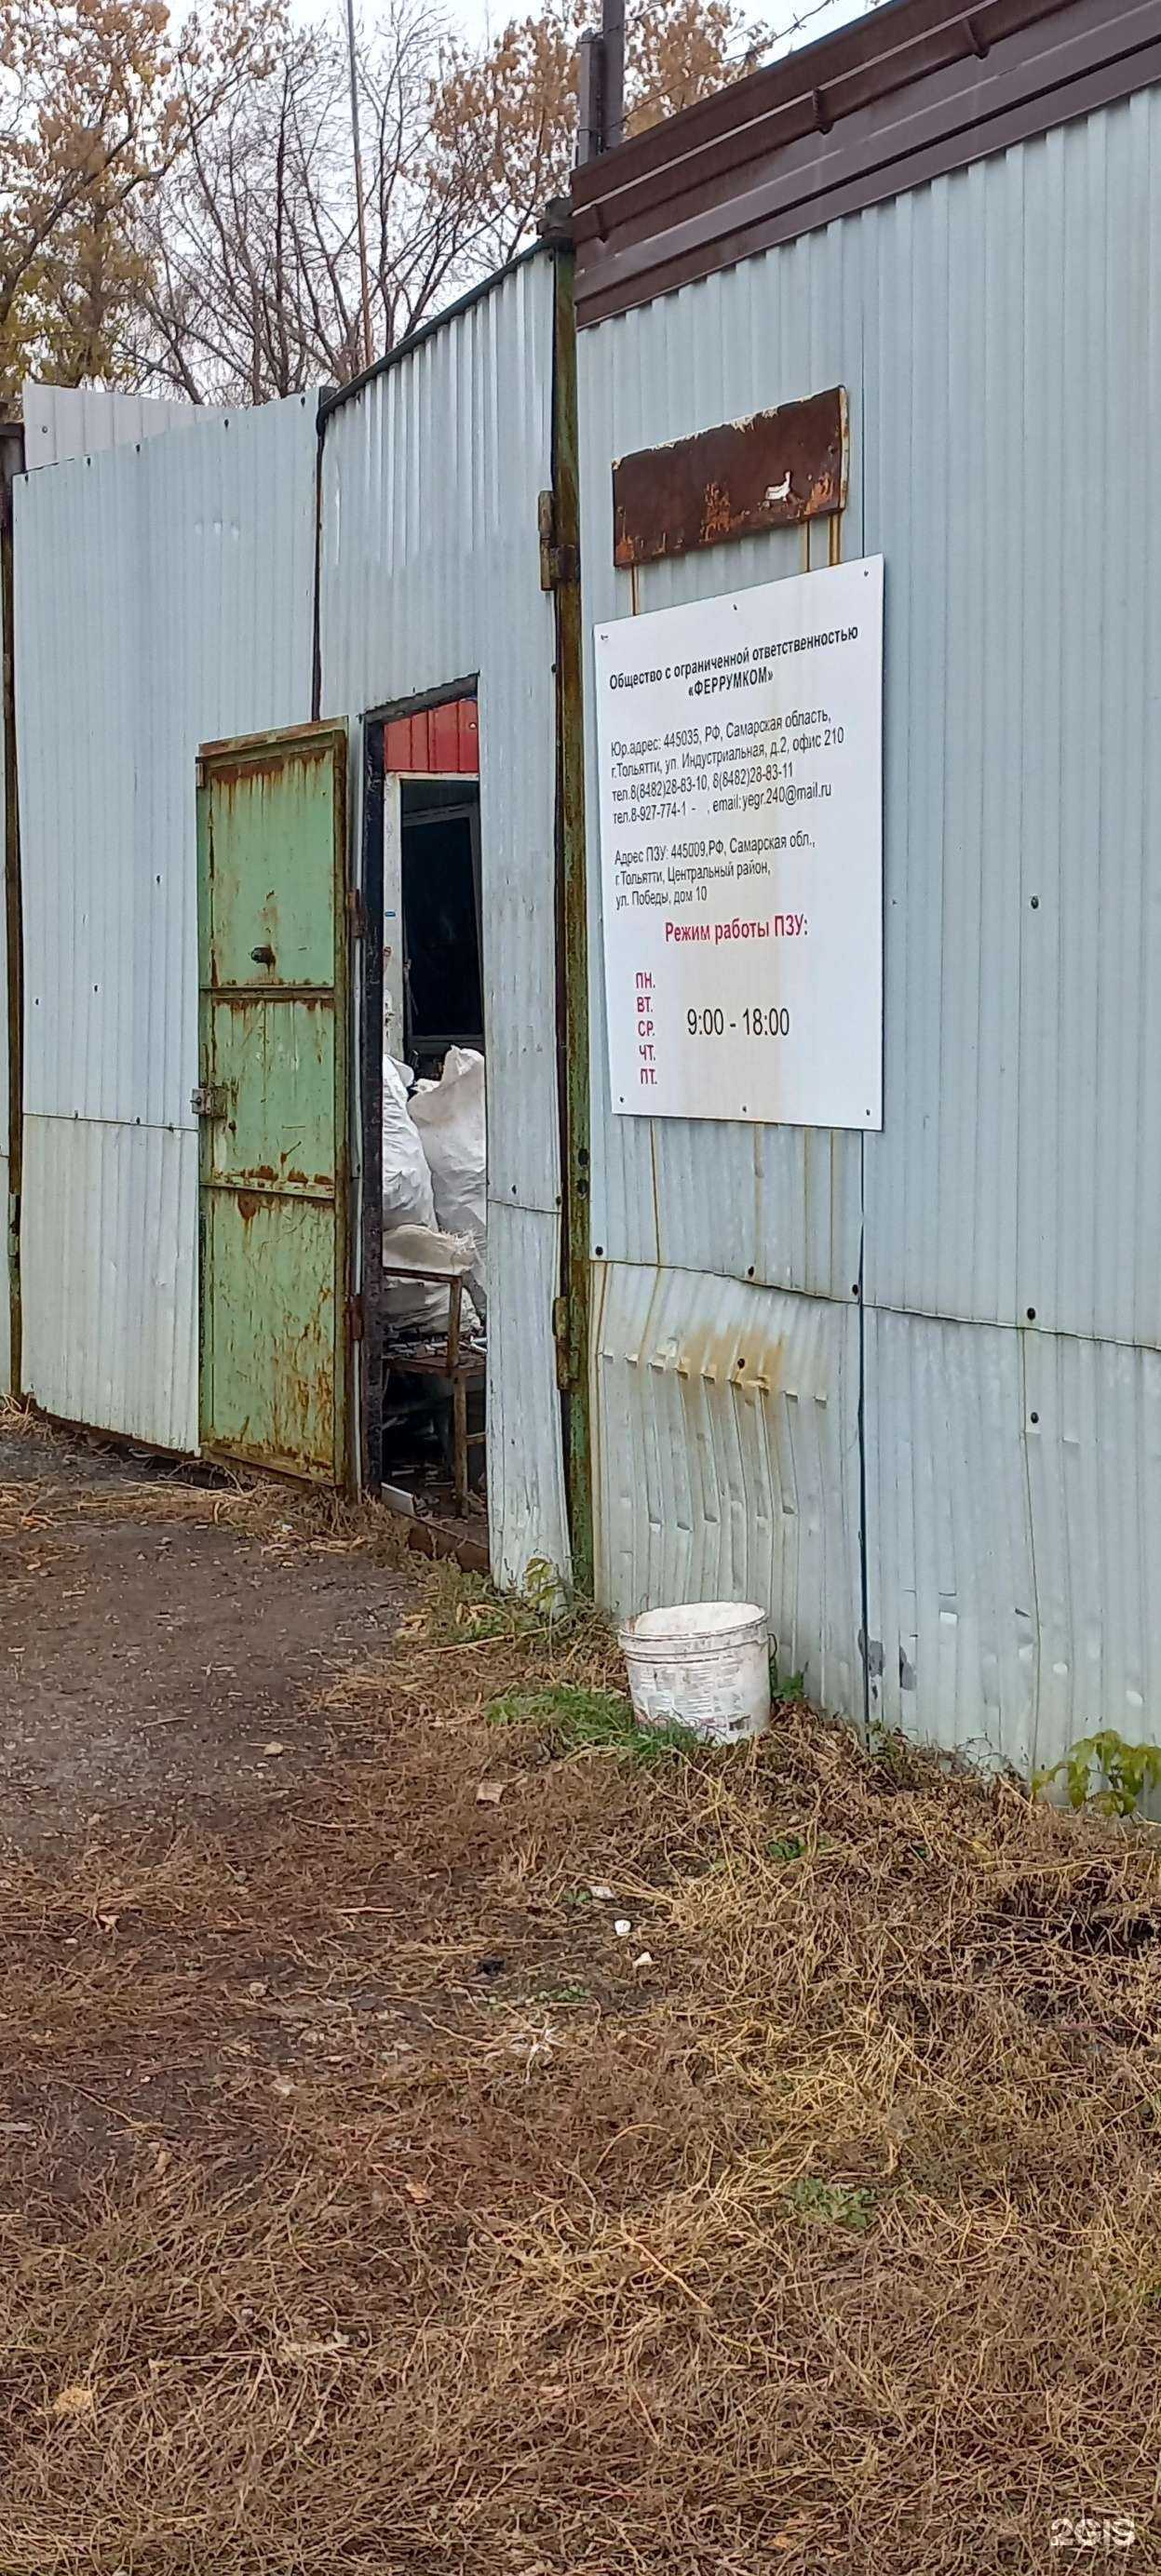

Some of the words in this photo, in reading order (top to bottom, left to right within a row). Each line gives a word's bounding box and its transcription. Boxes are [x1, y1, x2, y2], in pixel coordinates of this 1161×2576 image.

[610, 670, 662, 691] Общество
[665, 666, 671, 679] с
[673, 648, 749, 679] ограниченной
[752, 626, 858, 662] ответственностью
[688, 666, 774, 697] «ФЕРРУМКОМ»
[611, 738, 661, 759] Юр.адрес:
[664, 728, 702, 748] 445035,
[705, 725, 723, 743] РФ,
[726, 717, 782, 739] Самарская
[785, 708, 831, 728] область,
[611, 760, 663, 779] г.Тольятти,
[682, 742, 768, 771] Индустриальная,
[792, 732, 821, 755] офис
[824, 726, 844, 746] 210
[712, 762, 793, 791] 8(8482)28-83-11
[613, 800, 686, 825] тел.8-927-774-1
[614, 848, 644, 866] Адрес
[646, 845, 668, 863] ПЗУ:
[729, 835, 787, 857] Самарская
[667, 861, 735, 885] Центральный
[736, 858, 771, 880] район,
[615, 893, 629, 910] ул.
[631, 889, 671, 907] Победы,
[673, 888, 693, 904] дом
[695, 886, 708, 901] 10
[665, 920, 710, 942] Режим
[714, 917, 770, 945] работы
[775, 914, 808, 937] ПЗУ:
[635, 972, 656, 988] ПН.
[636, 996, 654, 1013] ВТ.
[638, 1020, 655, 1038] СР.
[687, 1008, 724, 1036] 9:00
[742, 1008, 790, 1036] 18:00
[639, 1044, 656, 1061] ЧТ.
[640, 1067, 658, 1085] ПТ.
